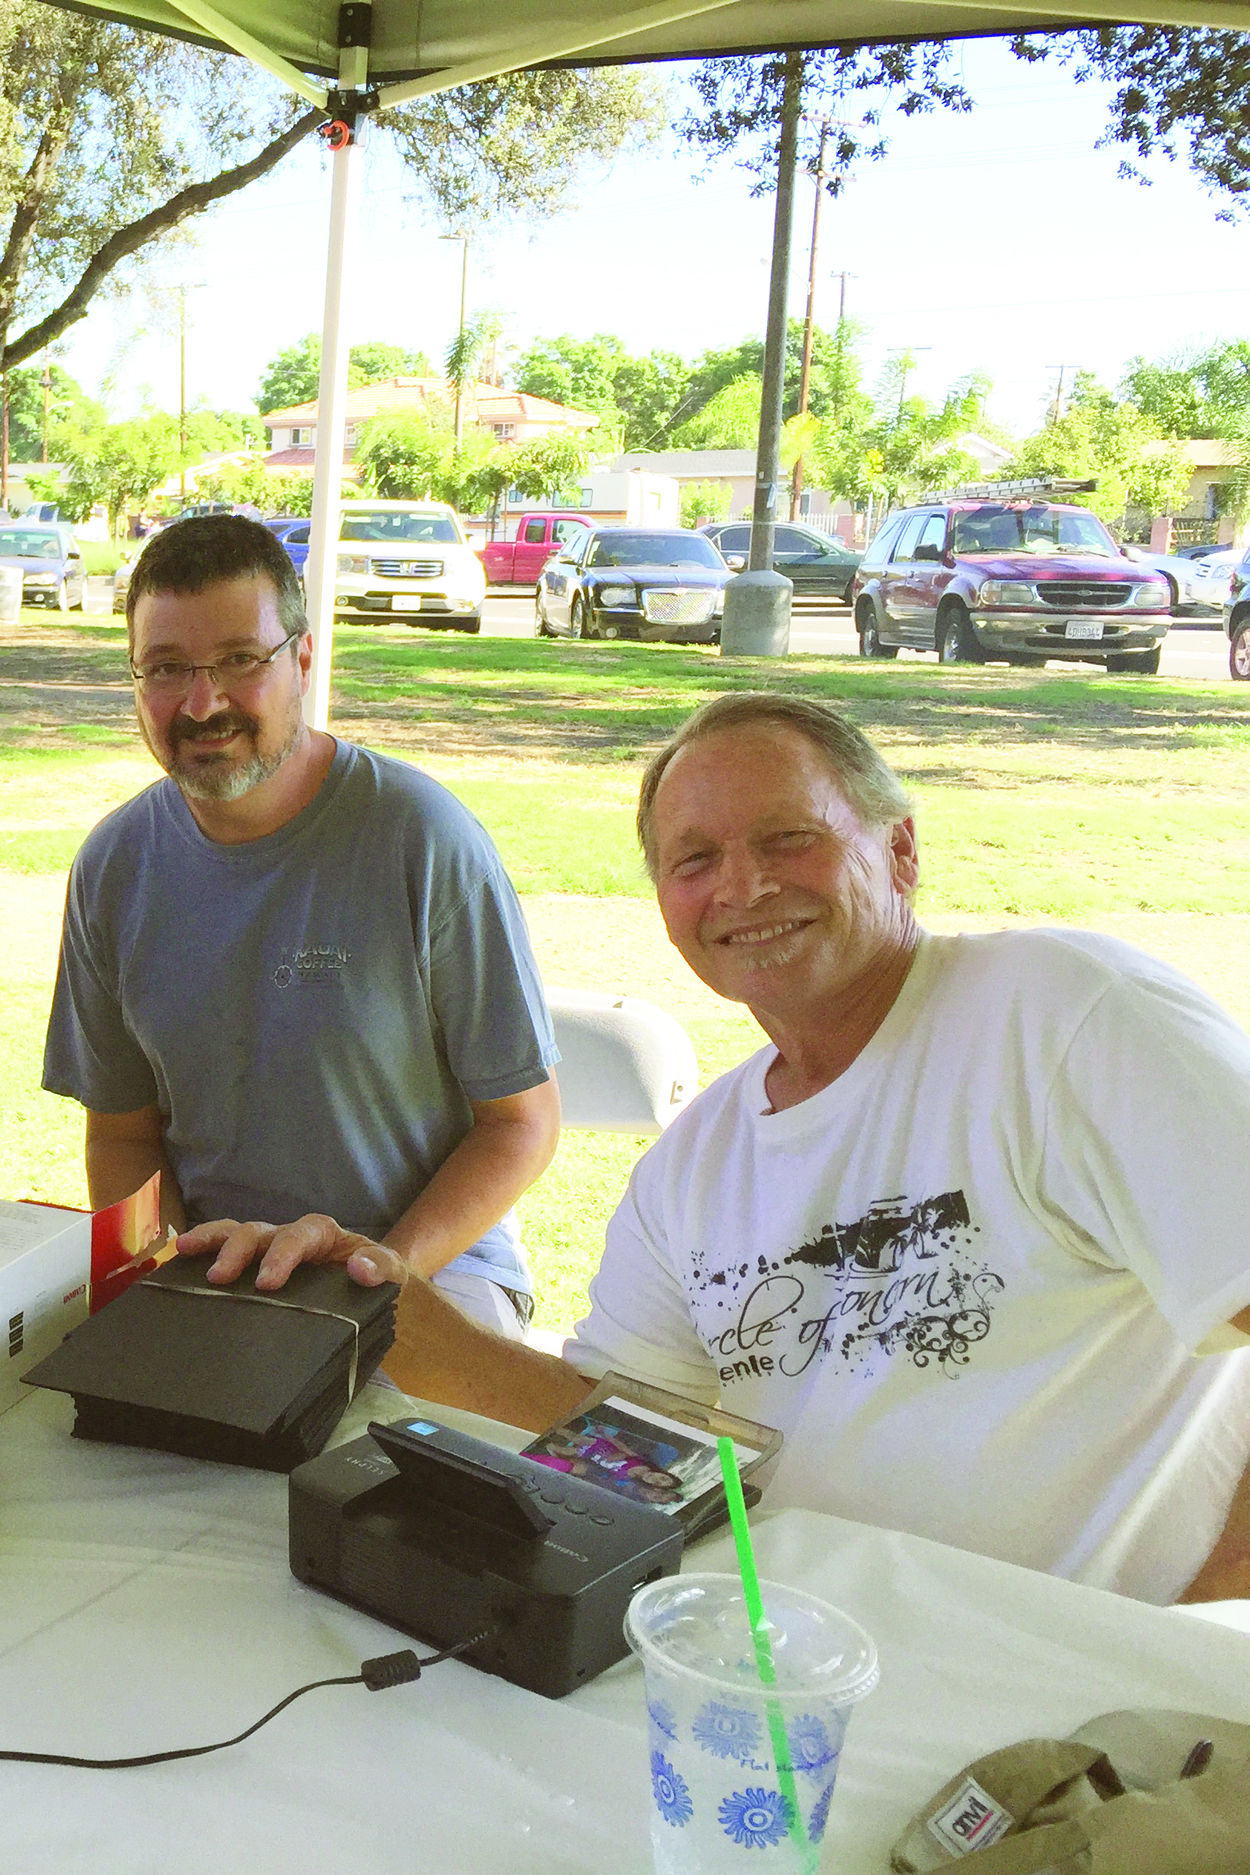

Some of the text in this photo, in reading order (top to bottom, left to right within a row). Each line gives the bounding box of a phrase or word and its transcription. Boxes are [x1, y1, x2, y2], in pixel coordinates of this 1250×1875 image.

[296, 960, 342, 969] COFFEE
[778, 1300, 842, 1377] of
[951, 1795, 989, 1837] anvil
